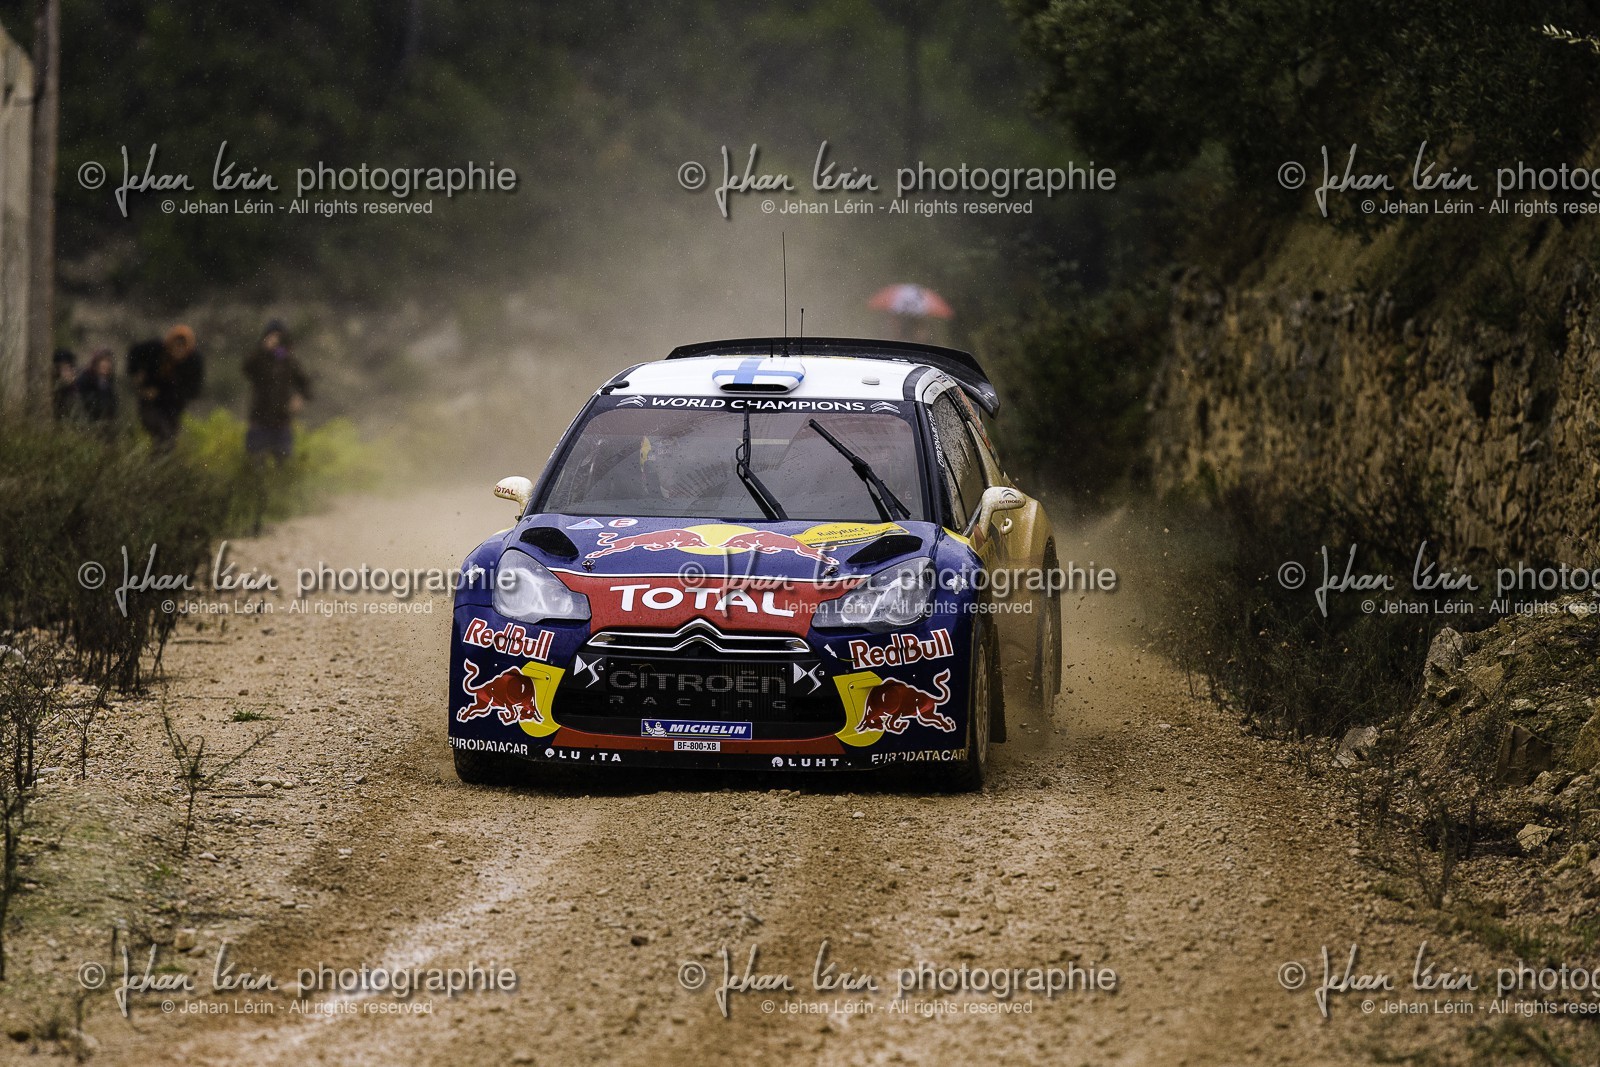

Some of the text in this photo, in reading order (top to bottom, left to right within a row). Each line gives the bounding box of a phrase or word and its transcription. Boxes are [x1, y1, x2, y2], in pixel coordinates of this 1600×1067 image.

[652, 397, 866, 412] WORLD CHAMPIONS
[609, 583, 795, 618] TOTAL
[668, 723, 747, 735] MICHELIN
[677, 741, 717, 751] BF-800-XB
[559, 750, 622, 762] LUTA
[788, 758, 851, 767] LUHT
